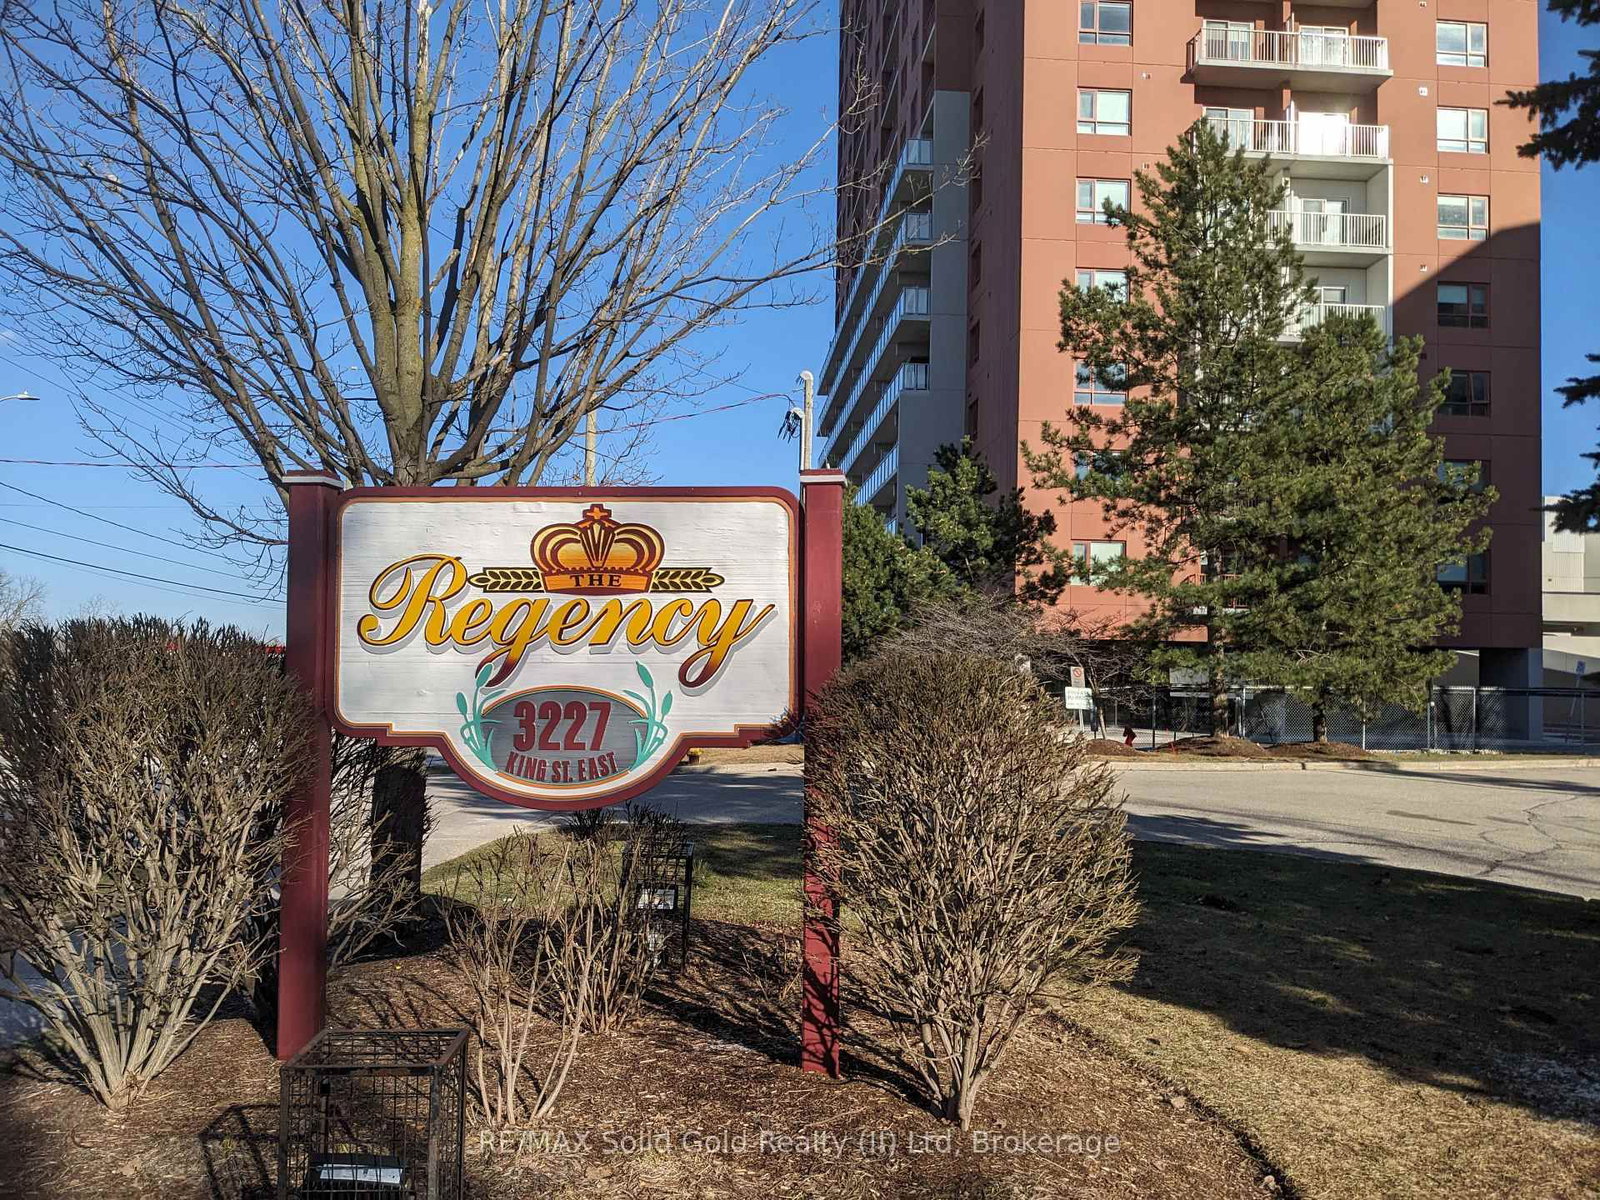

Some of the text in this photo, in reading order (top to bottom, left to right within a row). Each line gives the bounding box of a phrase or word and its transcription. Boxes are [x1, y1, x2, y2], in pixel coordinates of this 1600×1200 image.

[569, 574, 622, 587] THE
[357, 554, 775, 688] Regency
[513, 700, 612, 752] 3227
[505, 751, 619, 783] KING ST. EAST
